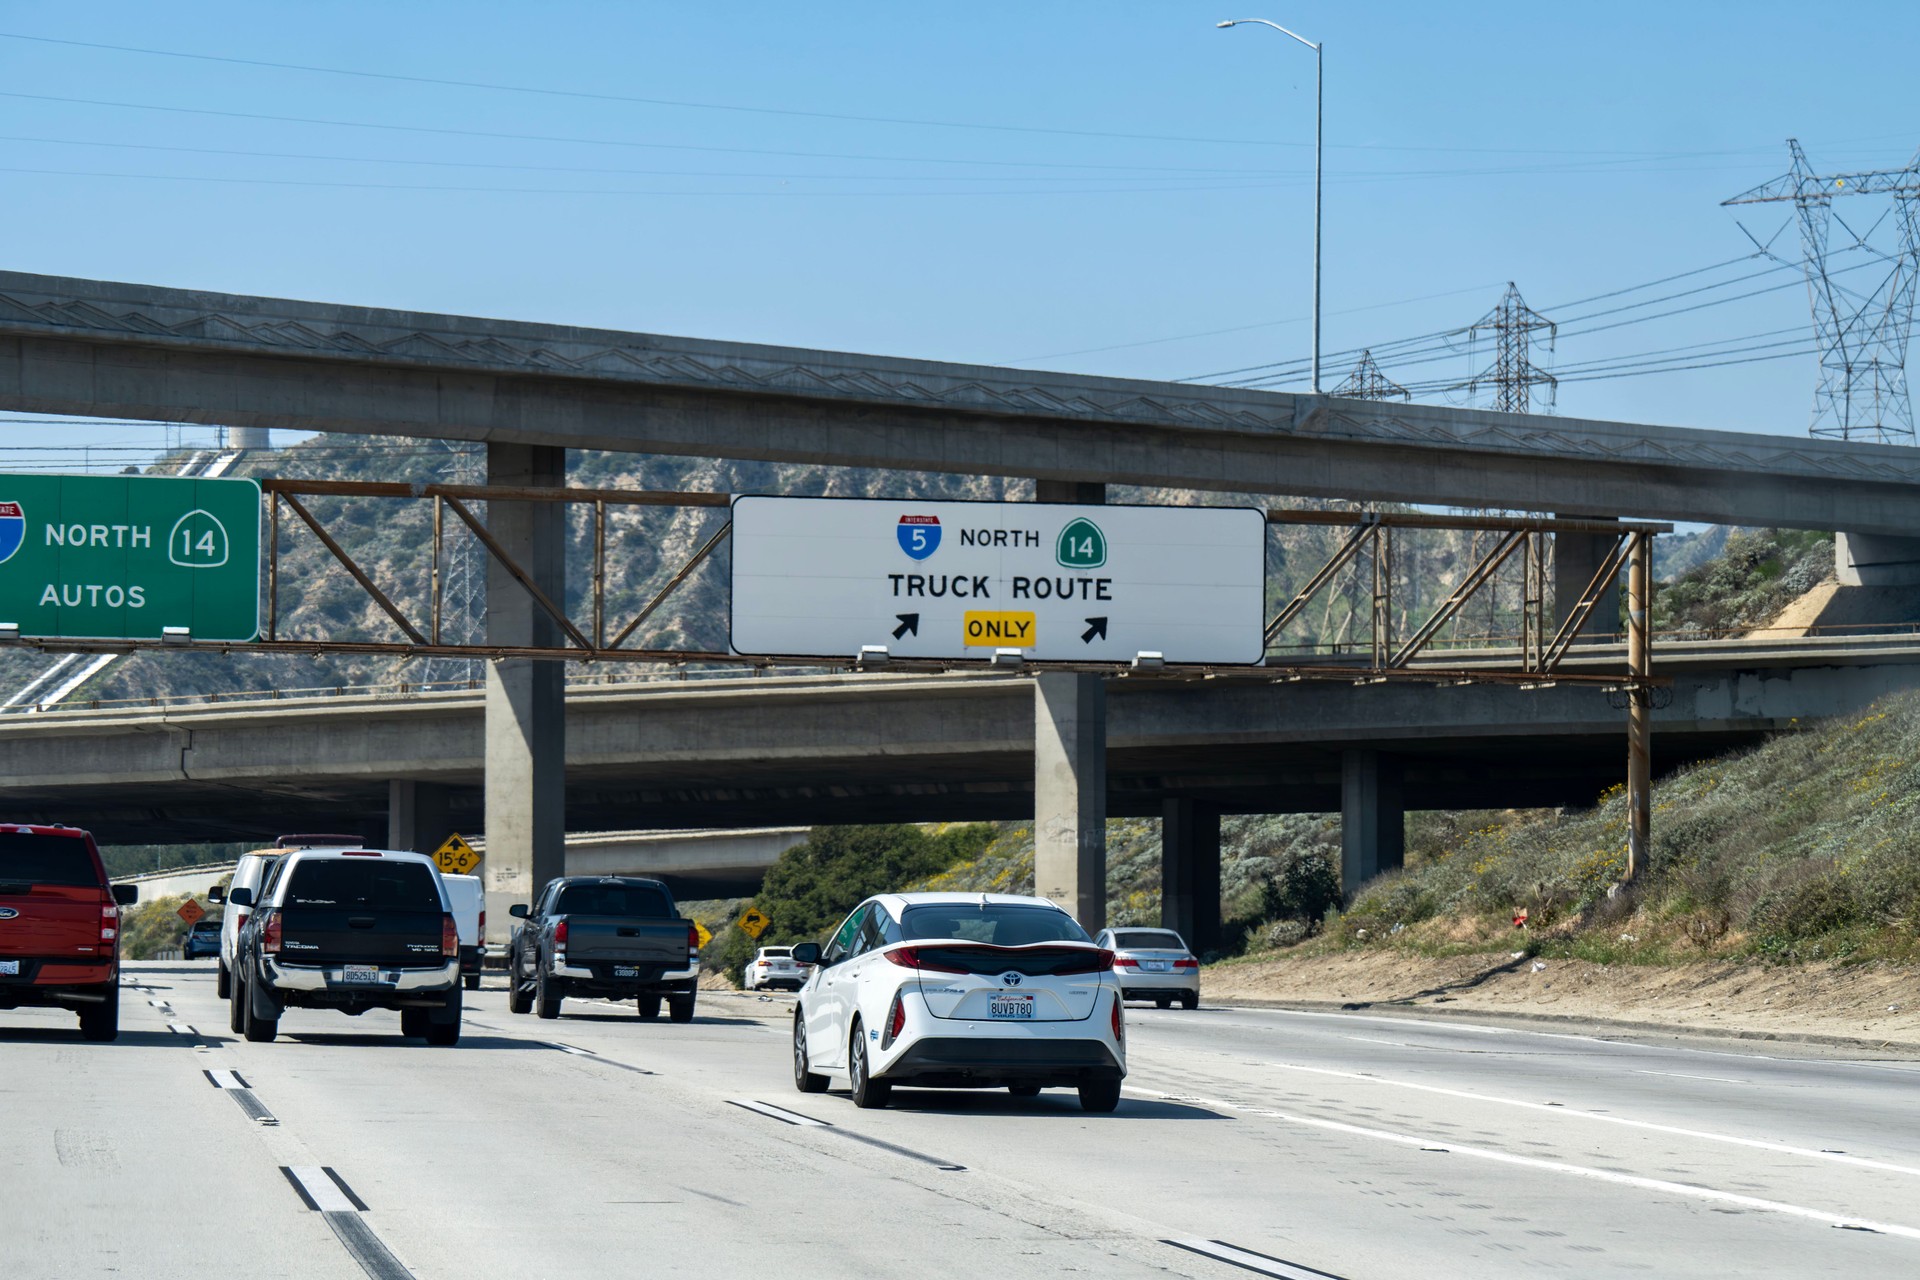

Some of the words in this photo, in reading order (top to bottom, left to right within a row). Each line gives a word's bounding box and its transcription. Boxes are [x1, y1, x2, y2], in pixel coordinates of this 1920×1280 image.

[46, 523, 151, 548] NORTH
[182, 529, 216, 557] 14
[912, 529, 927, 551] 5
[960, 528, 1040, 548] NORTH
[1069, 536, 1095, 560] 14
[39, 583, 146, 608] AUTOS
[887, 573, 991, 599] TRUCK
[1012, 576, 1113, 601] ROUTE
[968, 620, 1031, 639] ONLY
[345, 971, 377, 981] 8D52513
[991, 1002, 1032, 1015] 8UVB780
